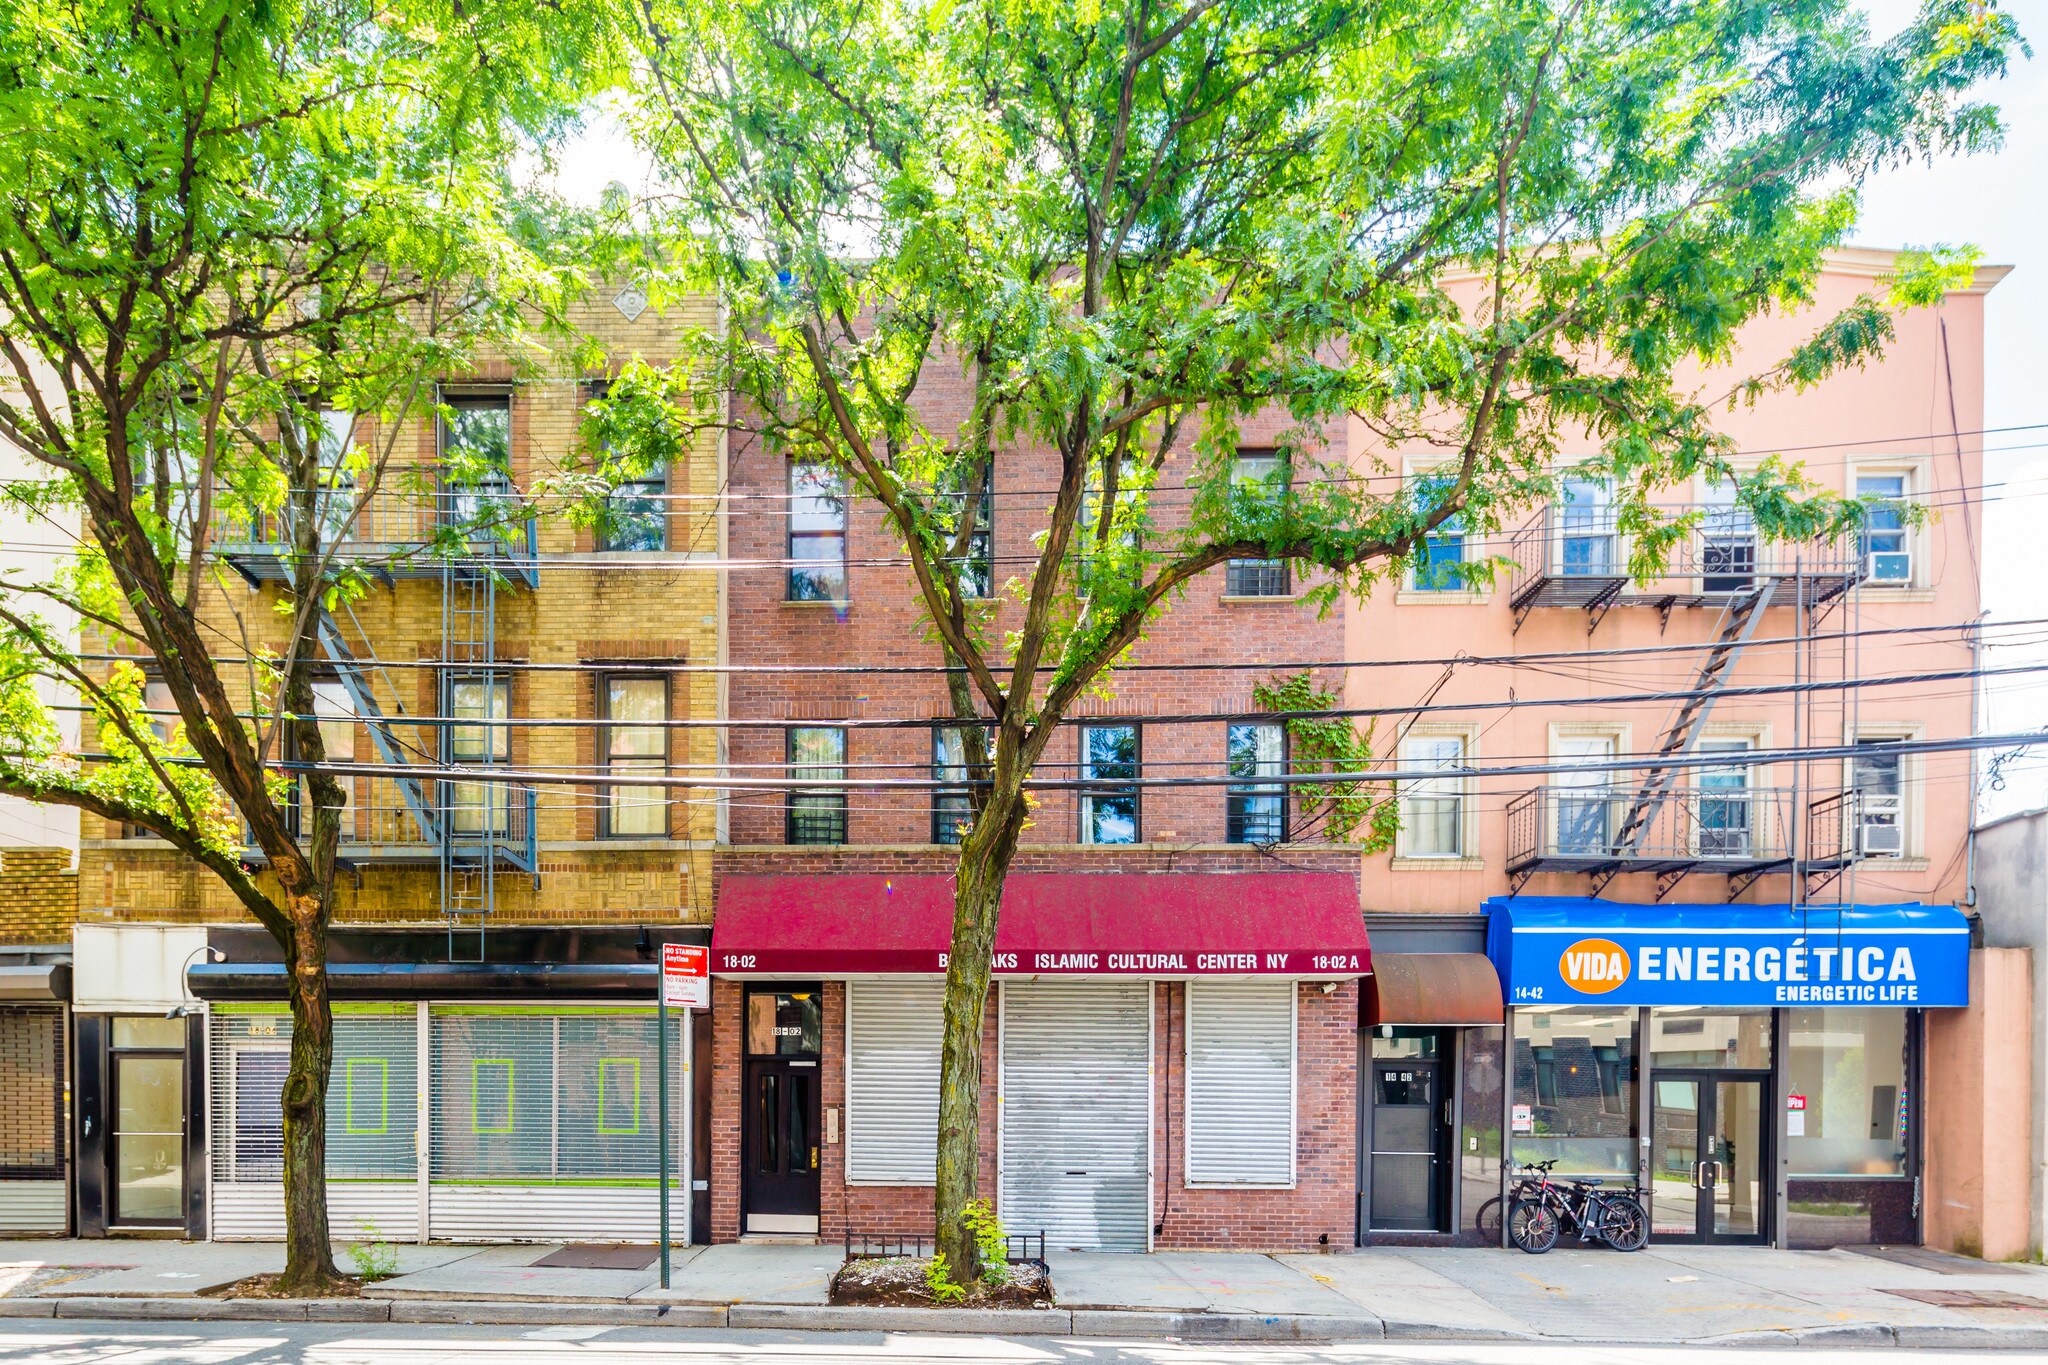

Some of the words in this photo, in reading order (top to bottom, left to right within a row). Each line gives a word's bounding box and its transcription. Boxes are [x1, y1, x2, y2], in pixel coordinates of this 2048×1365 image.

[675, 948, 702, 956] STANDING
[722, 954, 756, 968] 18-02
[1035, 953, 1099, 969] ISLAMIC
[1108, 953, 1188, 969] CULTURAL
[1196, 953, 1258, 969] CENTER
[1266, 953, 1289, 969] NY
[1312, 955, 1347, 969] 18-02
[1349, 955, 1360, 969] A
[1566, 952, 1624, 981] VIDA
[1638, 937, 1917, 982] ENERGÉTICA
[675, 977, 698, 985] PARKING
[1515, 986, 1543, 1000] 14-42
[1776, 985, 1875, 1001] ENERGETIC
[1879, 985, 1918, 1001] LIFE
[772, 1027, 801, 1035] 18-02
